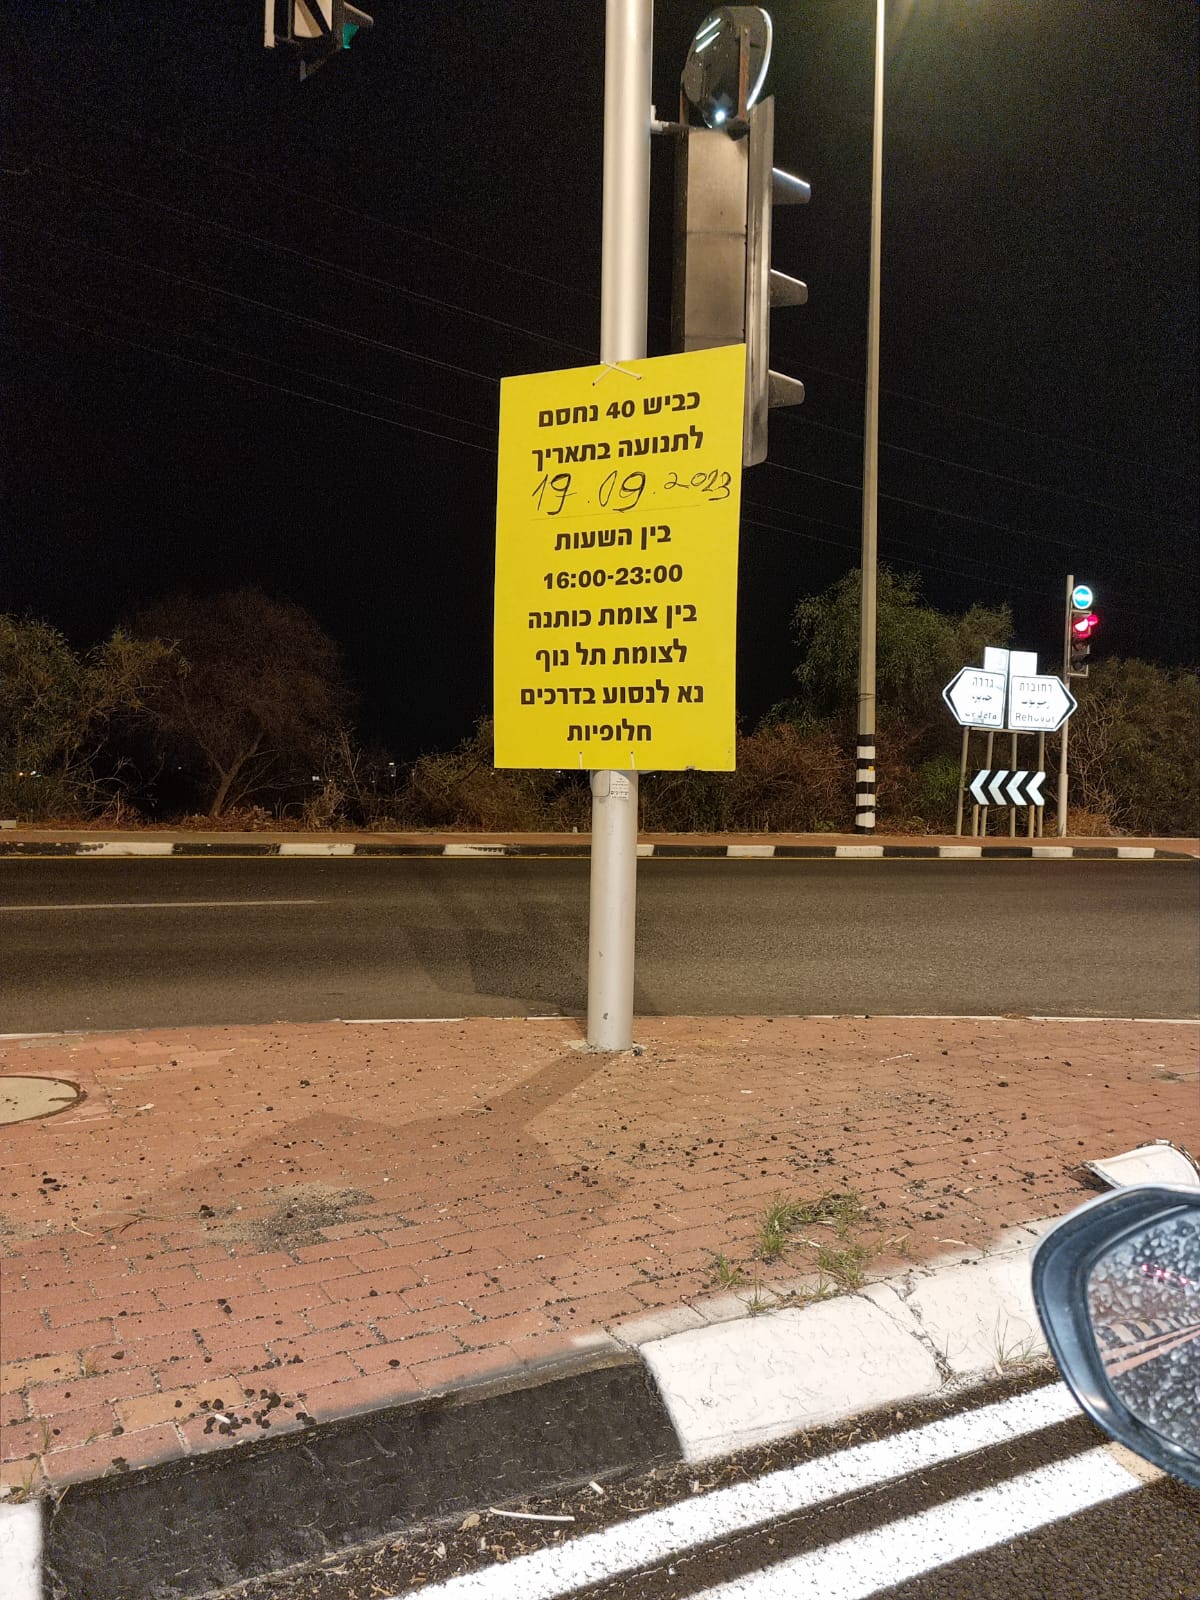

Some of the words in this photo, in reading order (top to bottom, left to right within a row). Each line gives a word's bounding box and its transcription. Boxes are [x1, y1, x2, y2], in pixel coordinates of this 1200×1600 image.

[606, 400, 635, 418] 40
[644, 392, 700, 415] כביש
[539, 405, 598, 427] נחסם
[619, 425, 703, 457] לתנועה
[532, 443, 610, 471] בתאריך
[555, 529, 632, 550] השעות
[641, 525, 671, 550] בין
[544, 565, 682, 589] 16:00-23:00
[529, 610, 591, 628] כותנה
[598, 606, 657, 626] צומת
[667, 605, 697, 629] בין
[536, 650, 568, 672] נוף
[576, 643, 605, 665] תל
[613, 639, 687, 664] לצומת
[521, 688, 595, 704] בדרכים
[603, 680, 669, 704] לנסוע
[678, 686, 703, 703] נא
[567, 719, 651, 741] חלופיות
